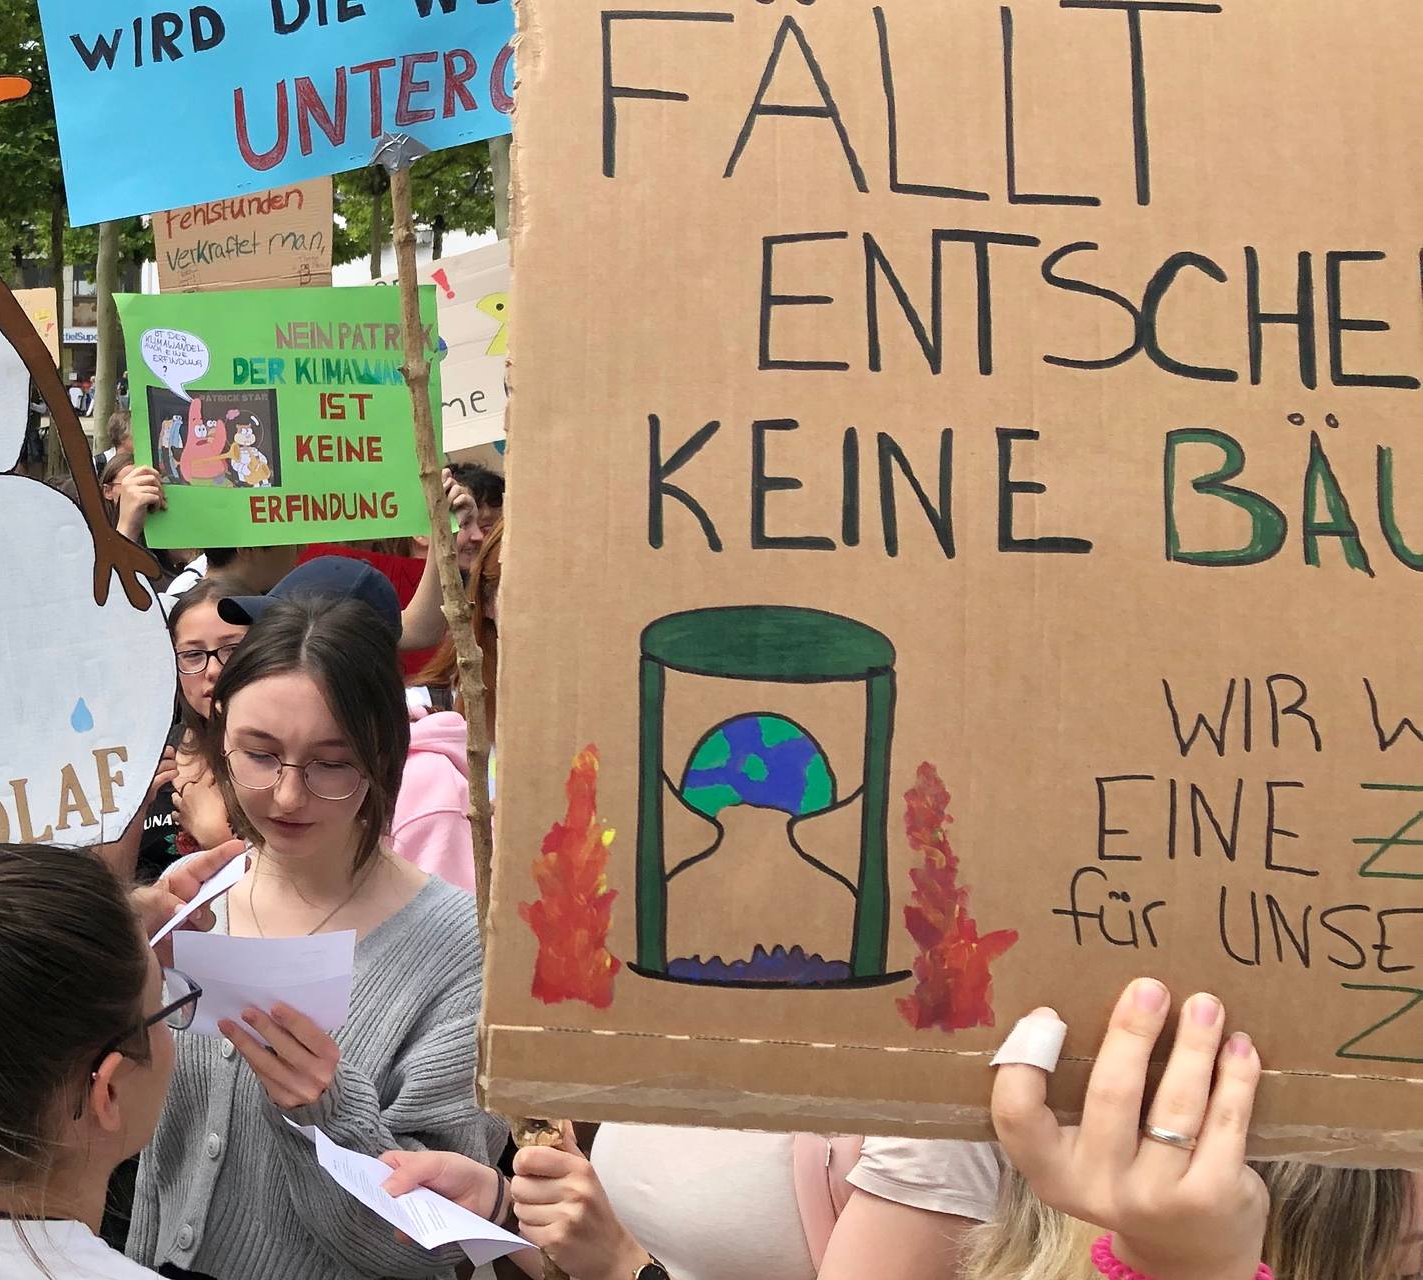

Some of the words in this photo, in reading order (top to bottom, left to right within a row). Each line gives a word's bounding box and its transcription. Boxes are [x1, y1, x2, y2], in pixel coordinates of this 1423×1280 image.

[70, 12, 226, 73] WIRD
[273, 0, 367, 35] DIE
[601, 0, 1224, 206] FÄLLT
[275, 321, 334, 350] NEIN
[337, 322, 435, 351] PATRK
[758, 227, 1423, 391] ENTSCHE
[233, 357, 286, 386] DER
[295, 356, 404, 386] KLIMAWAN
[320, 392, 374, 421] IST
[295, 435, 384, 463] KEINE
[249, 491, 399, 524] ERFINDUNG
[648, 413, 1093, 559] KEINE
[1162, 673, 1322, 758] WIR
[143, 813, 179, 831] UNA
[1095, 774, 1321, 878] EINE
[1052, 866, 1167, 950] für
[1219, 886, 1423, 974] UNSE
